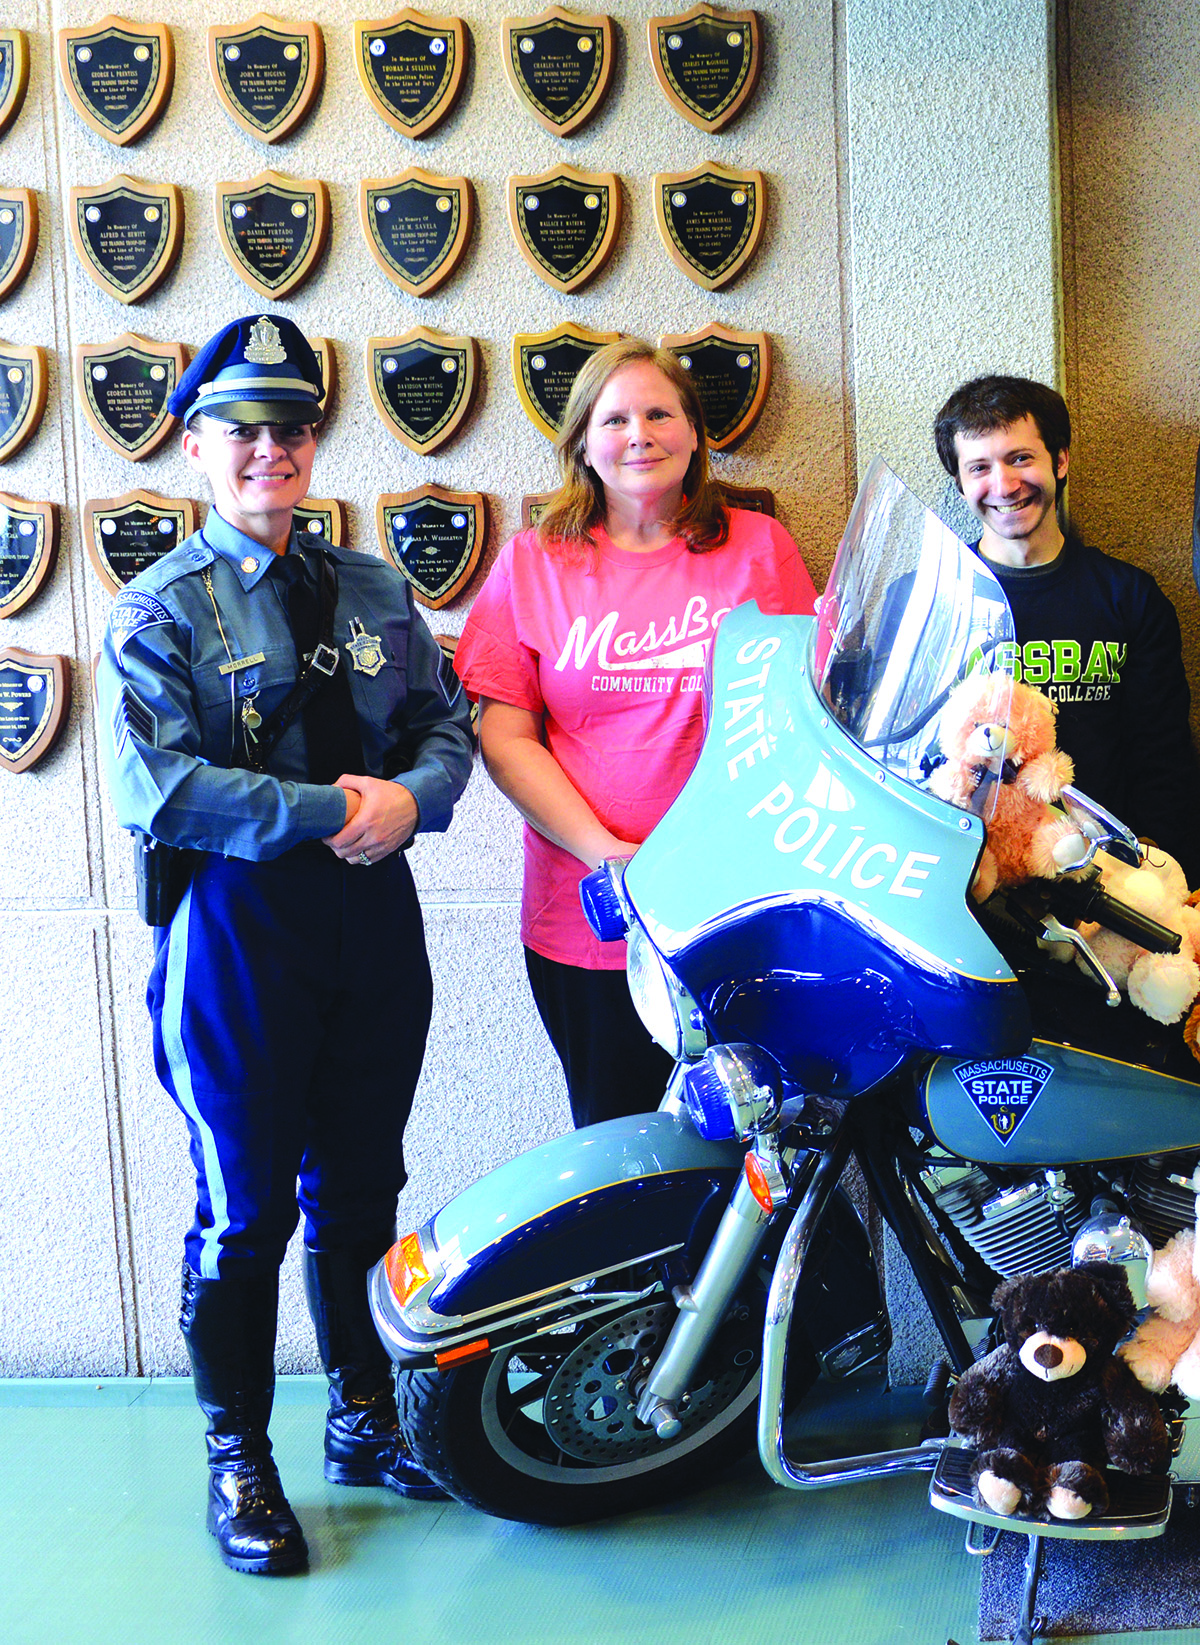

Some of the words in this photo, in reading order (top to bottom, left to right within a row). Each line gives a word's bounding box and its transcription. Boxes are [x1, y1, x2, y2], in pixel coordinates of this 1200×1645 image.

[112, 607, 152, 620] STATE
[554, 595, 731, 671] MassB
[592, 676, 674, 692] COMMUNITY
[1048, 685, 1111, 702] COLLEGE
[724, 636, 782, 782] STATE
[746, 780, 941, 899] POLICE
[959, 1060, 1047, 1080] MASSACHUSETTS
[972, 1081, 1032, 1094] STATE
[979, 1095, 1028, 1104] POLICE
